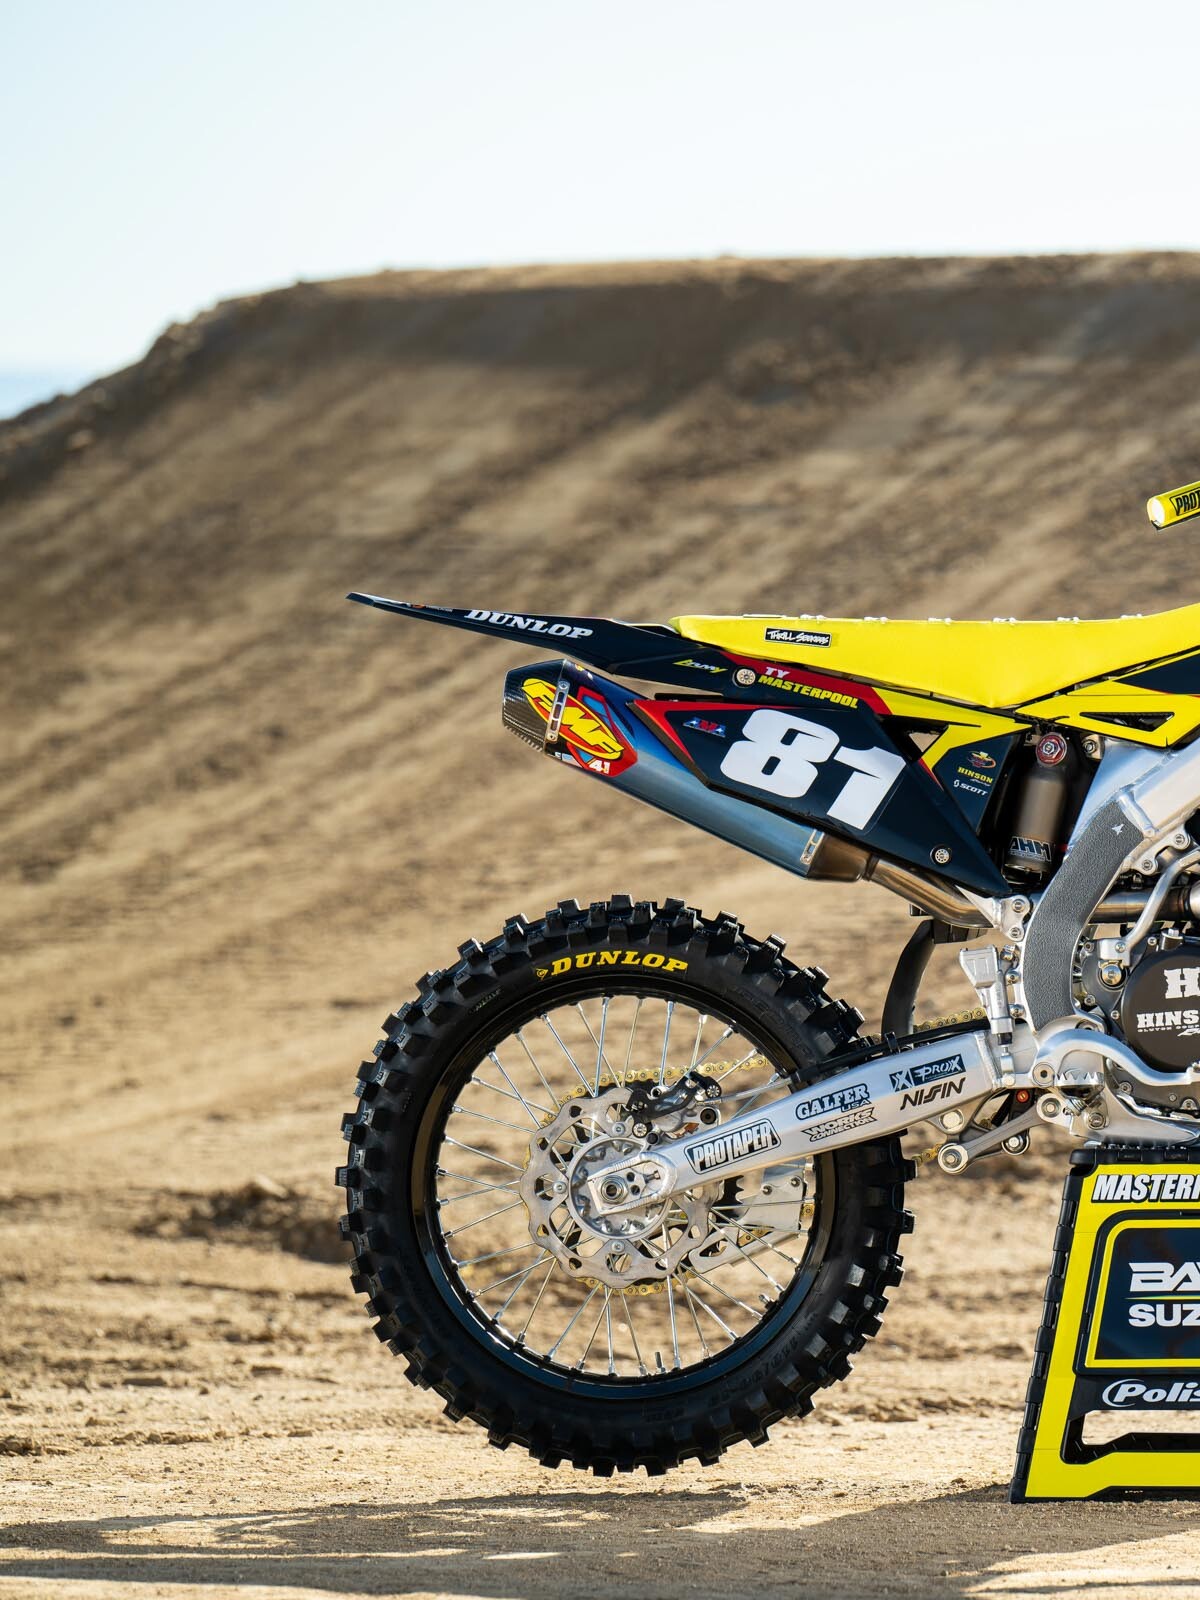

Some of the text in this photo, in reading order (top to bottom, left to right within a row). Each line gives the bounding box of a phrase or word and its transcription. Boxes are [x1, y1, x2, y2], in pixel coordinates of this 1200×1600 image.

[464, 609, 594, 639] DUNLOP
[764, 666, 790, 679] TY
[758, 675, 858, 709] MASTERPOOL
[719, 708, 906, 830] 81
[957, 766, 993, 784] HINSON
[960, 782, 988, 796] SCOTT
[1010, 836, 1051, 862] AHM
[551, 951, 688, 976] DUNLOP
[796, 1083, 870, 1120] GALFER
[841, 1100, 872, 1112] USA
[900, 1077, 967, 1111] NISSIN
[802, 1107, 875, 1135] WORKS
[810, 1118, 877, 1142] CONNECTION
[692, 1125, 776, 1174] PROTAPER
